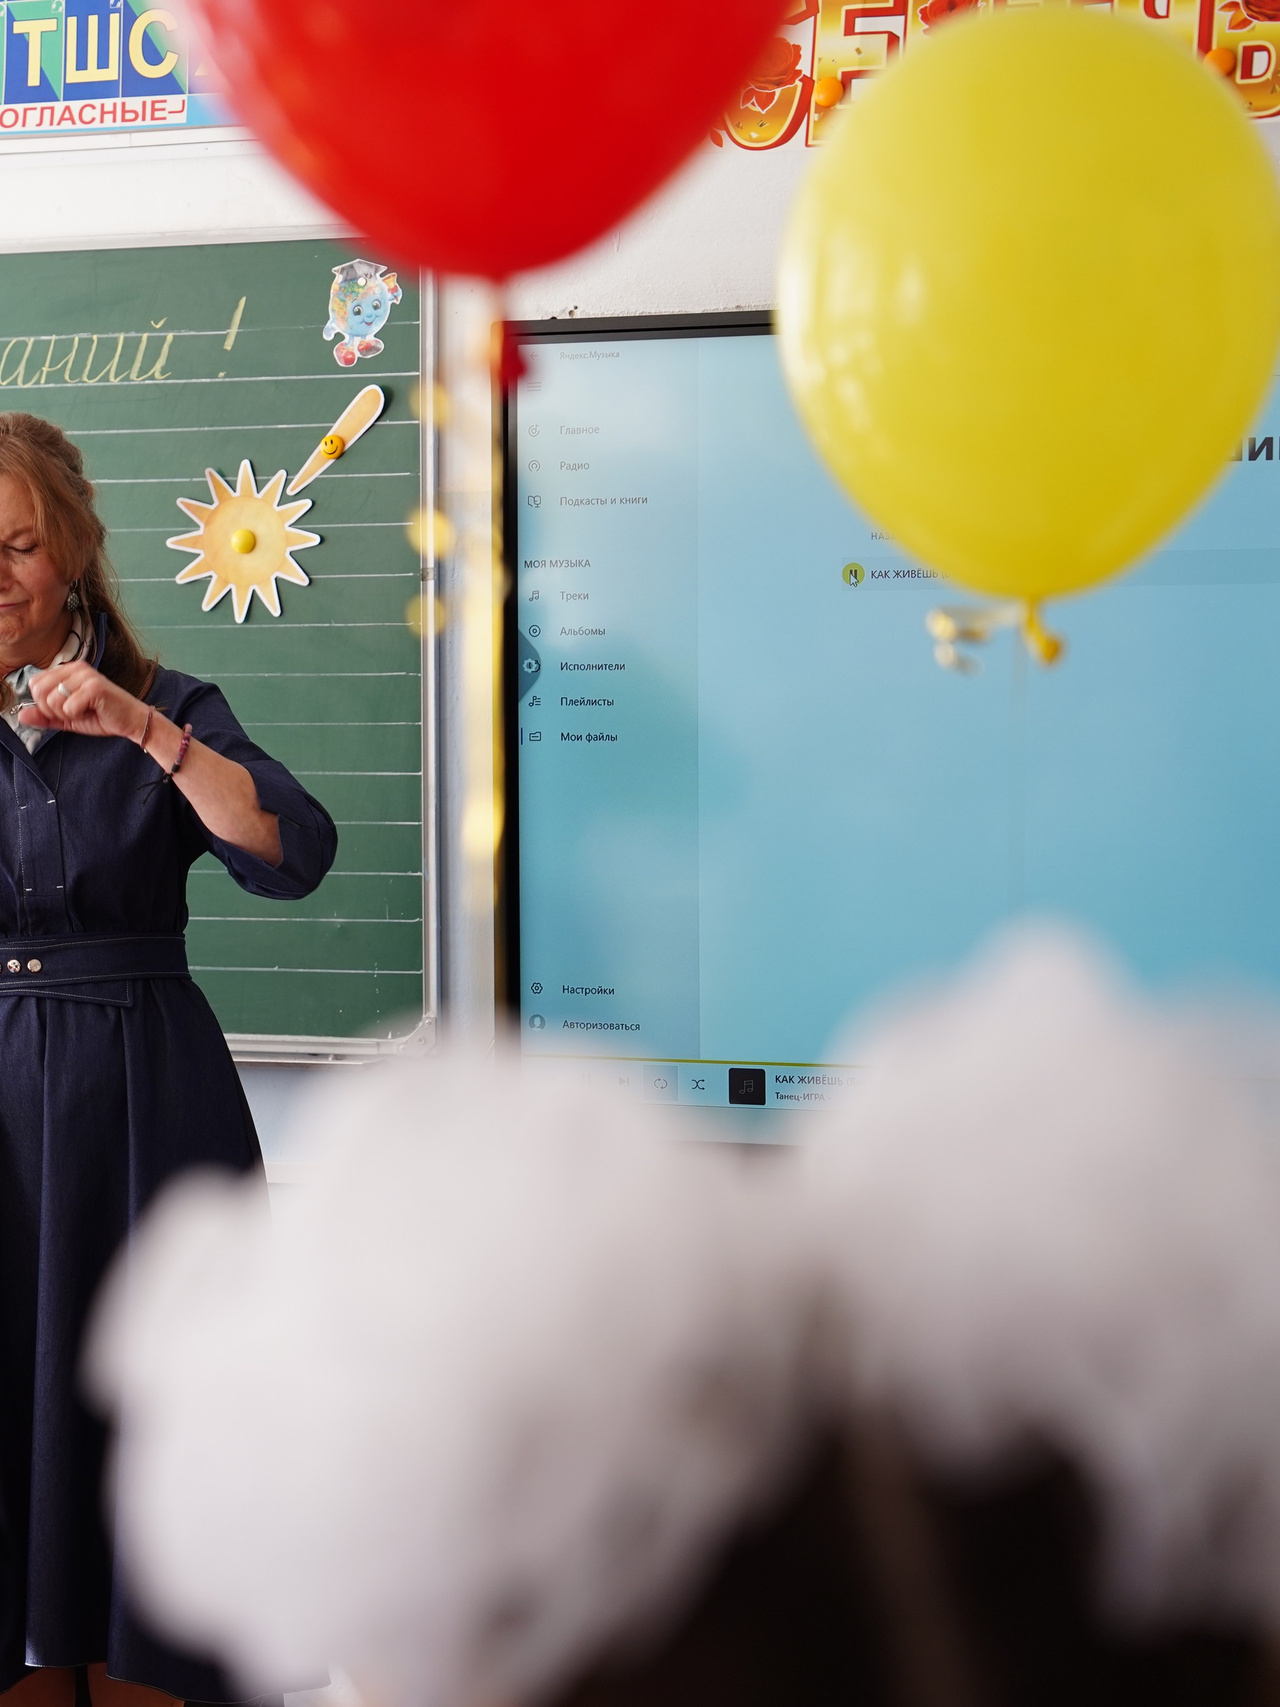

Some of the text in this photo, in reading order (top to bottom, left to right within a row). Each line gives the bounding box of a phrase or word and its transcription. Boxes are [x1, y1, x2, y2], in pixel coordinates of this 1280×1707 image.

[560, 351, 620, 360] Яндекс.Музыка
[560, 425, 600, 435] Главное
[560, 461, 590, 471] Радио
[560, 496, 648, 507] Подкасты и книги
[524, 559, 591, 568] МОЯ МУЗЫКА
[871, 569, 890, 579] КАК
[892, 567, 939, 579] ЖИВЁШЬ
[560, 591, 589, 602] Треки
[559, 626, 606, 636] Альбомы
[560, 661, 626, 671] Исполнители
[560, 696, 615, 707] Плейлисты
[560, 732, 618, 743] Мои файлы
[562, 985, 615, 996] Настройки
[562, 1020, 640, 1031] Авторизоваться
[775, 1074, 795, 1084] КАК
[797, 1074, 843, 1085] ЖИВЁШЬ
[775, 1091, 825, 1102] Танец-ИГРА
